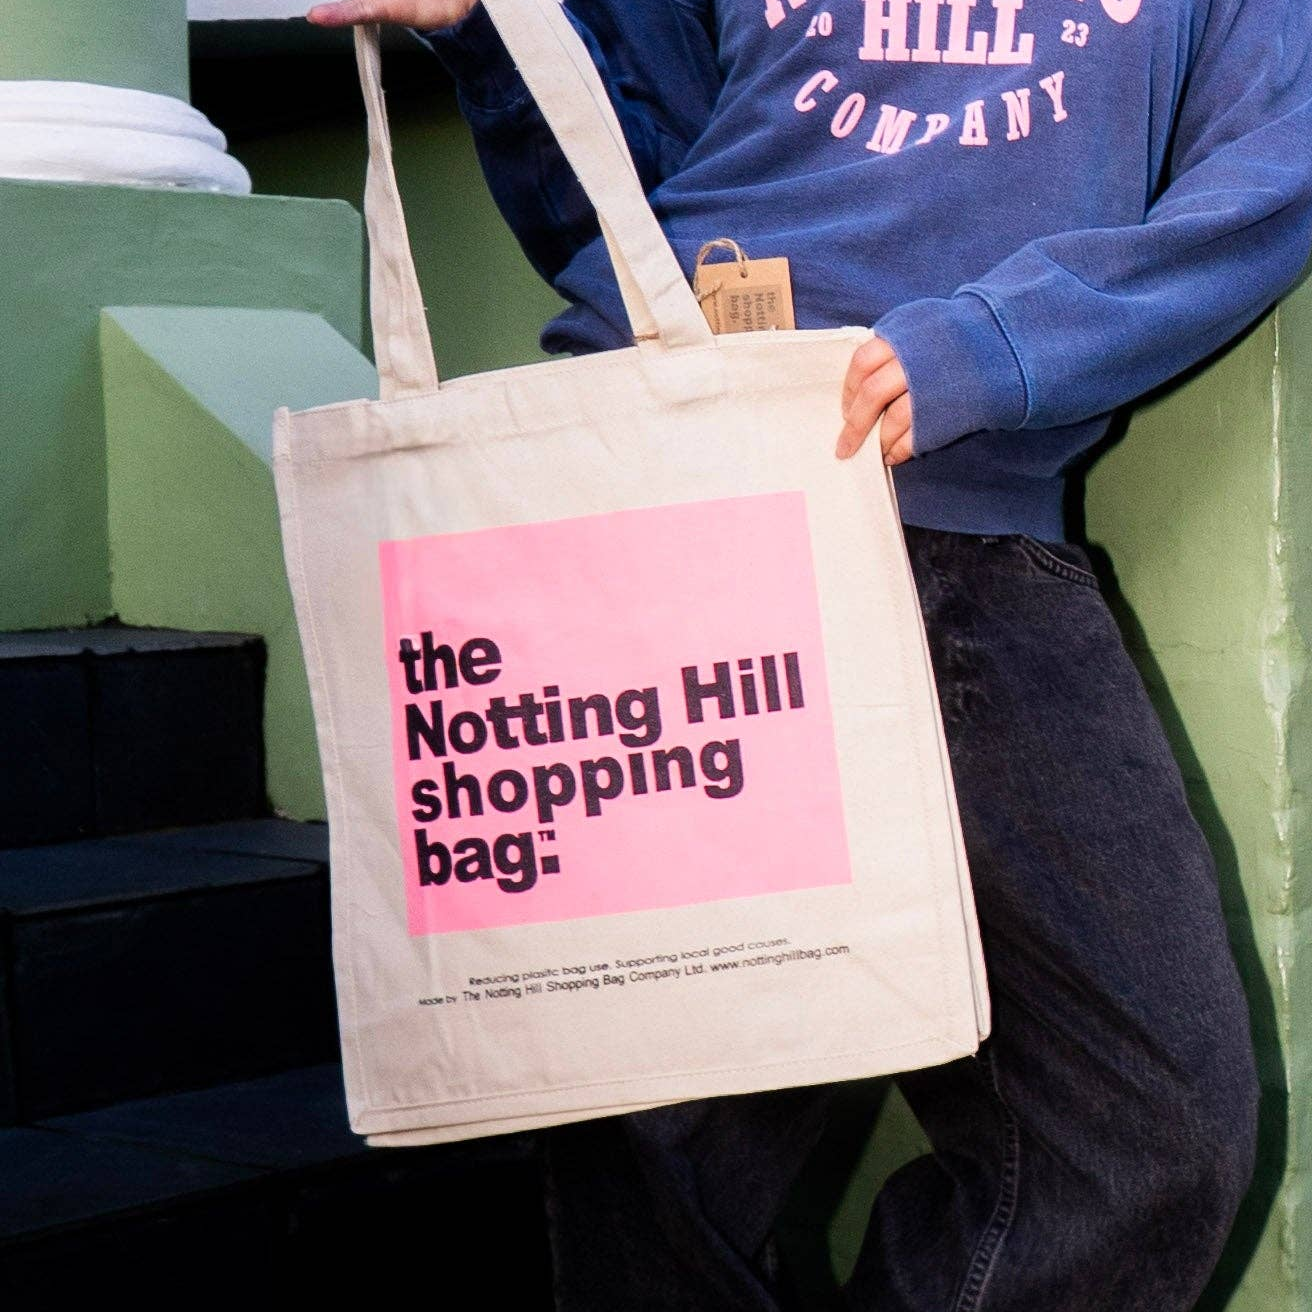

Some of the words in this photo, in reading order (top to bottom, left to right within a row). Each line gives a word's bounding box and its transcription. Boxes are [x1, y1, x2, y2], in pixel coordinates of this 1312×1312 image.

[1061, 19, 1090, 48] 23
[794, 70, 1068, 155] COMPANY
[399, 631, 502, 694] the
[405, 685, 662, 760] Notting
[682, 652, 805, 724] Hill
[411, 739, 745, 823] shopping
[462, 991, 480, 1002] The
[485, 988, 521, 999] Notting
[525, 983, 542, 994] Hill
[546, 977, 600, 992] Shopping
[603, 974, 625, 986] Bag
[629, 968, 680, 982] Company
[562, 966, 586, 976] bag
[615, 954, 678, 969] Supporting
[681, 948, 709, 959] local
[713, 944, 744, 957] good
